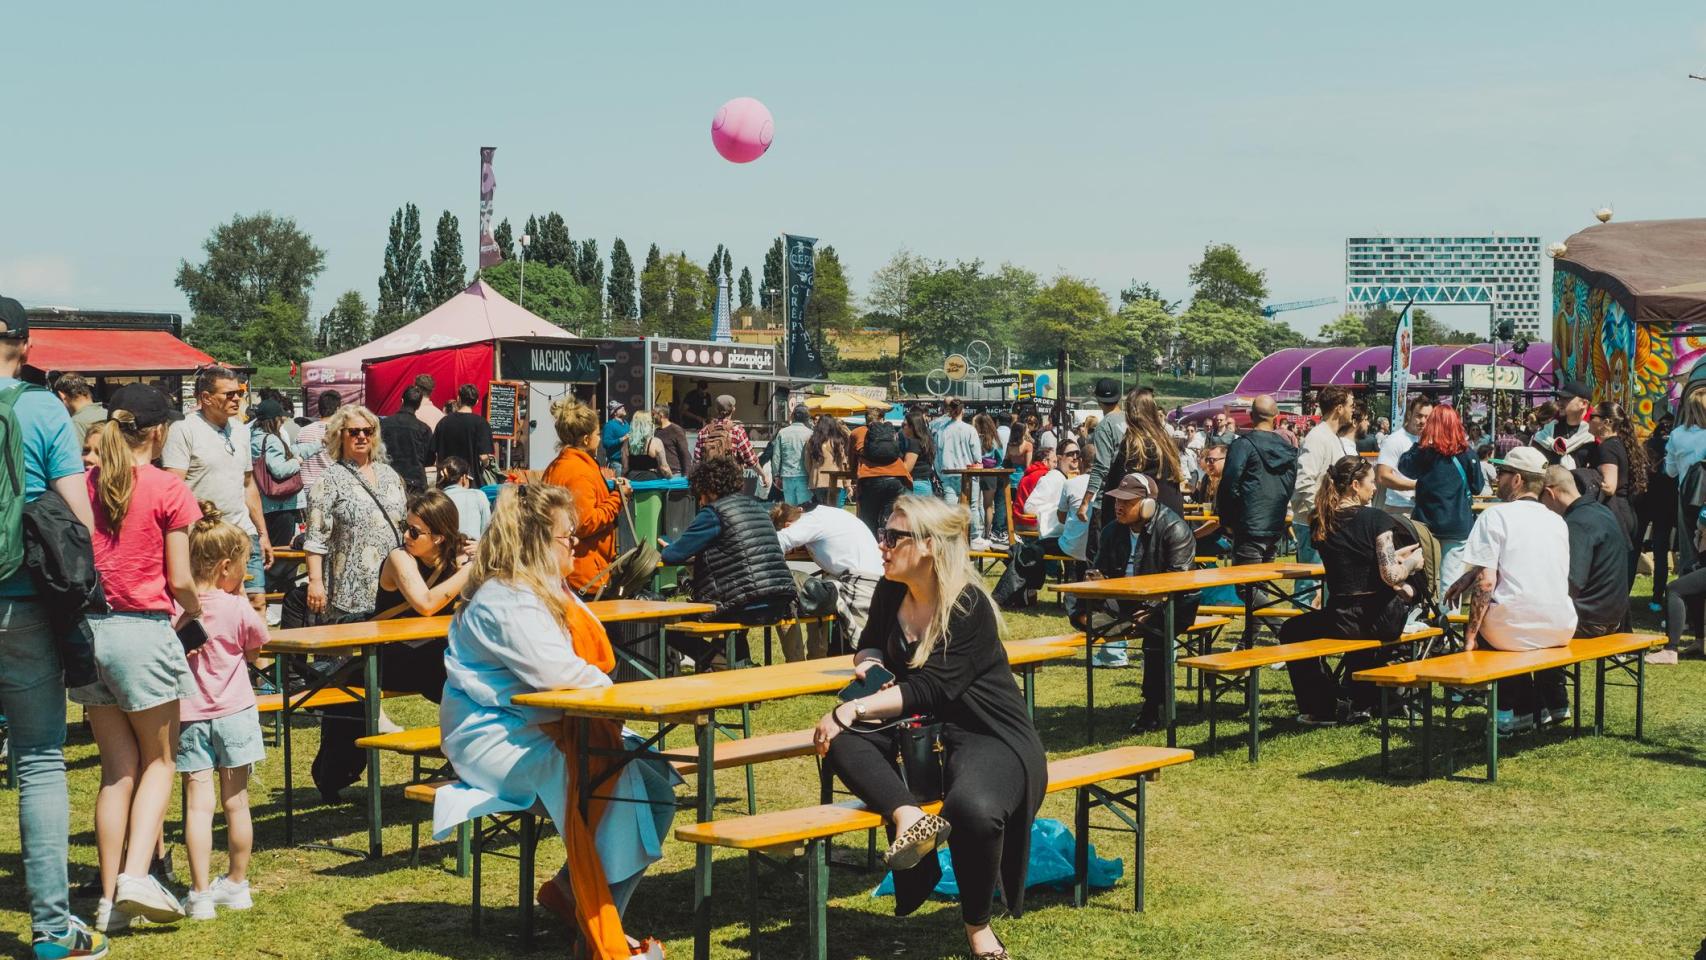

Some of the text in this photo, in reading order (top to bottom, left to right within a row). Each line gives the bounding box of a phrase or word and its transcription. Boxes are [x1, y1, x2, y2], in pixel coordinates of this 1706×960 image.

[531, 348, 572, 373] NACHOS
[728, 349, 772, 369] pizzapig.it
[1033, 397, 1055, 406] ORDER
